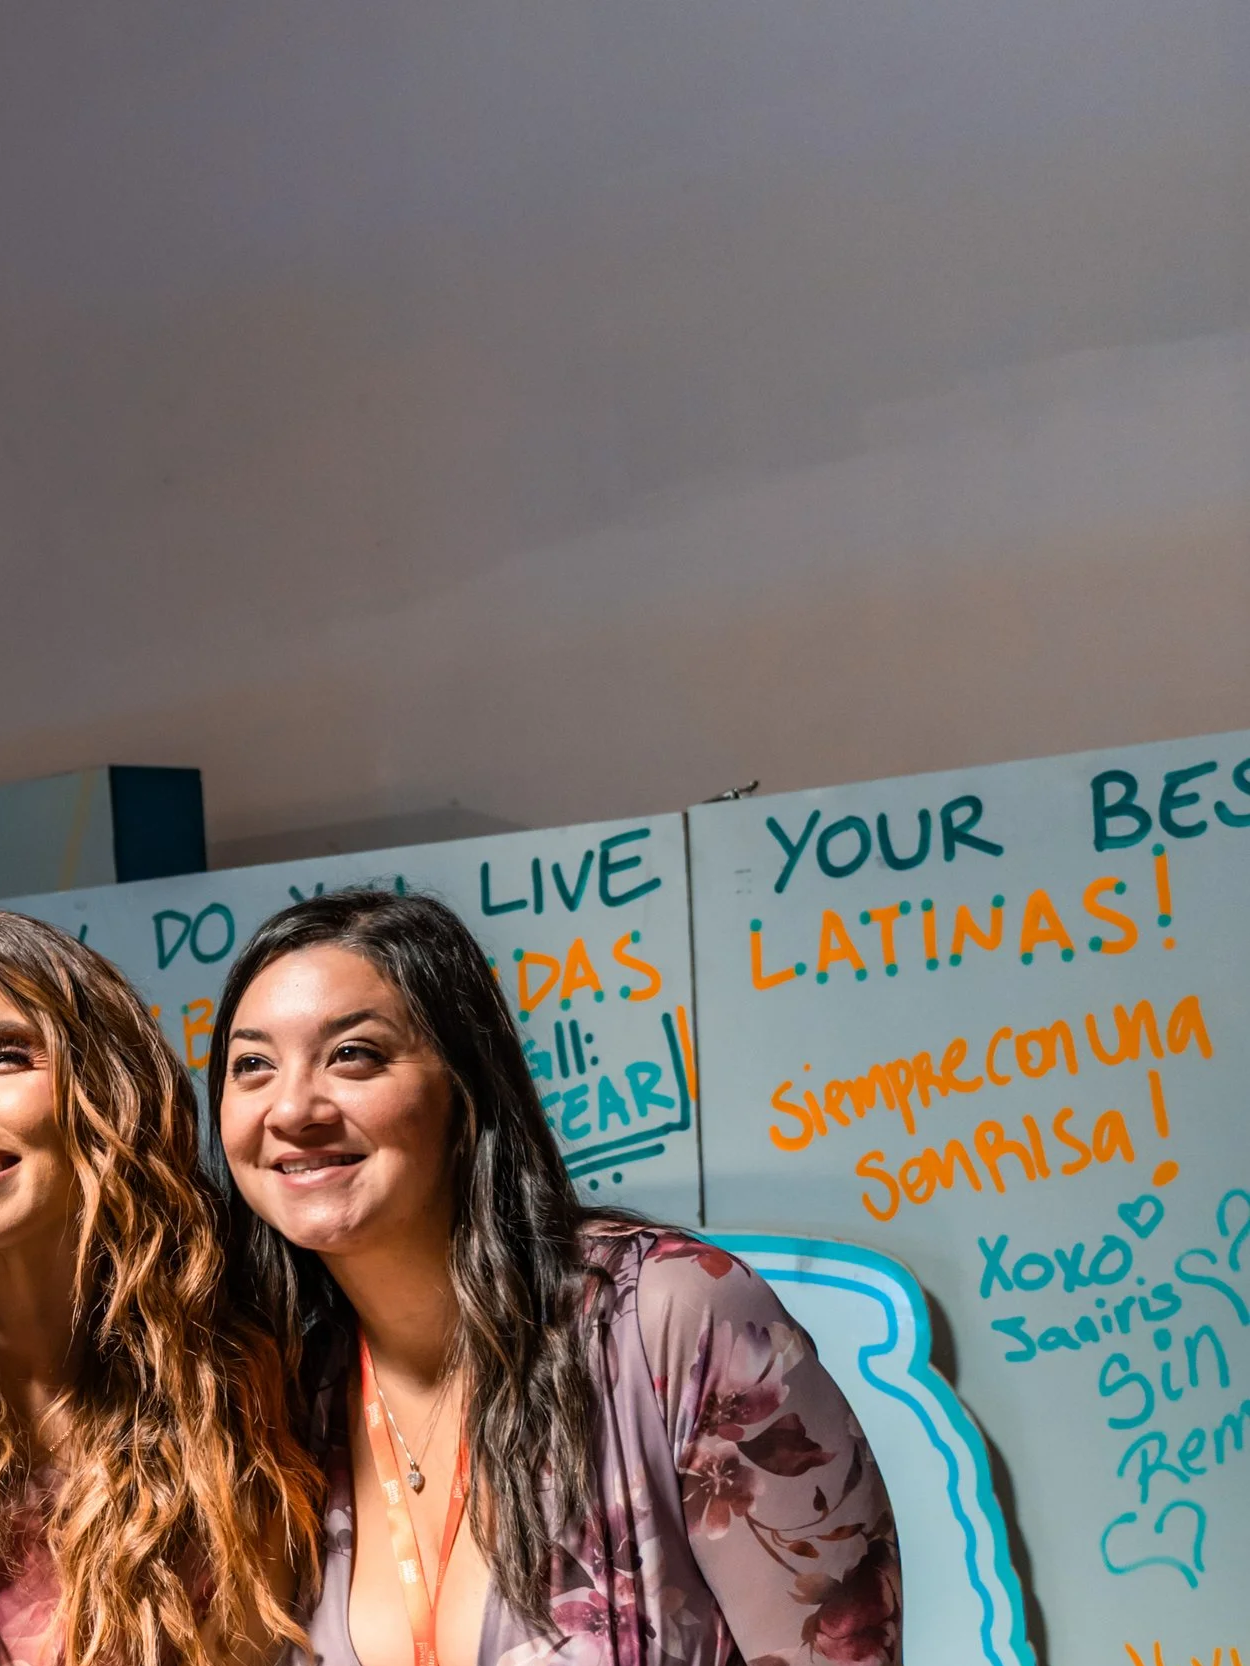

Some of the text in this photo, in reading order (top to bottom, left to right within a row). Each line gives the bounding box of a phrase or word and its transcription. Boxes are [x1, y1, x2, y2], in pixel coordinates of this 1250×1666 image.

[480, 827, 661, 917] LIVE
[766, 795, 1004, 893] YOUR
[153, 902, 236, 970] DO
[1098, 1324, 1231, 1431] Sin
